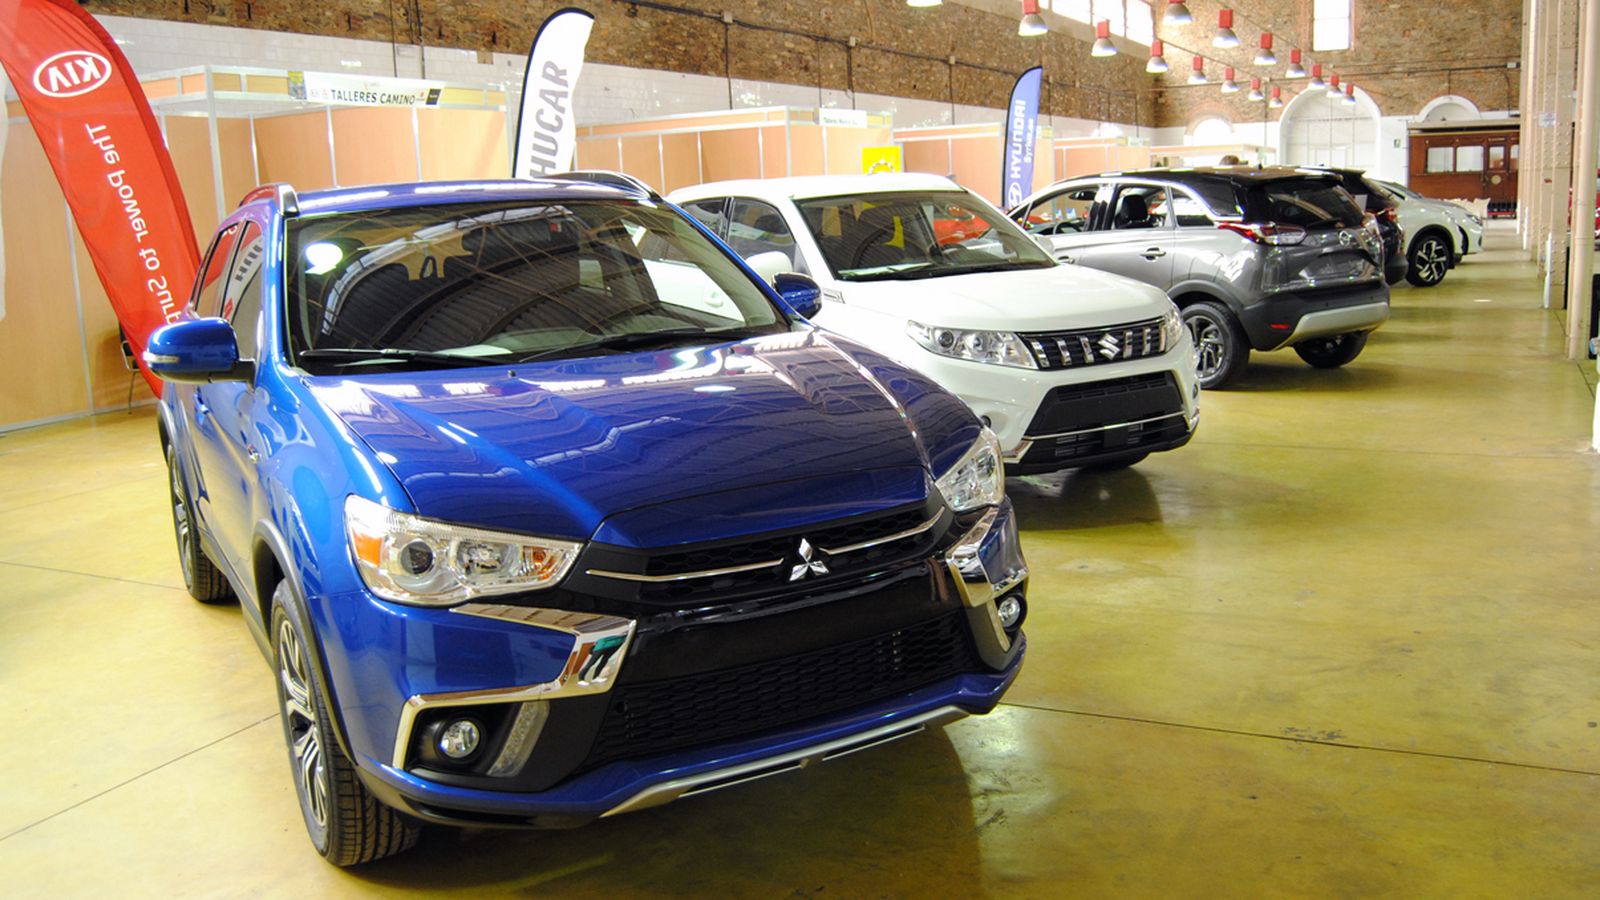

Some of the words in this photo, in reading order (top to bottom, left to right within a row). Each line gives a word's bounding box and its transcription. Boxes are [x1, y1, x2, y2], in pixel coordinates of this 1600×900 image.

[331, 89, 377, 103] TALLERES
[380, 92, 416, 105] CAMINO
[529, 60, 569, 179] HUCAR
[1010, 99, 1026, 179] HYUNDAI
